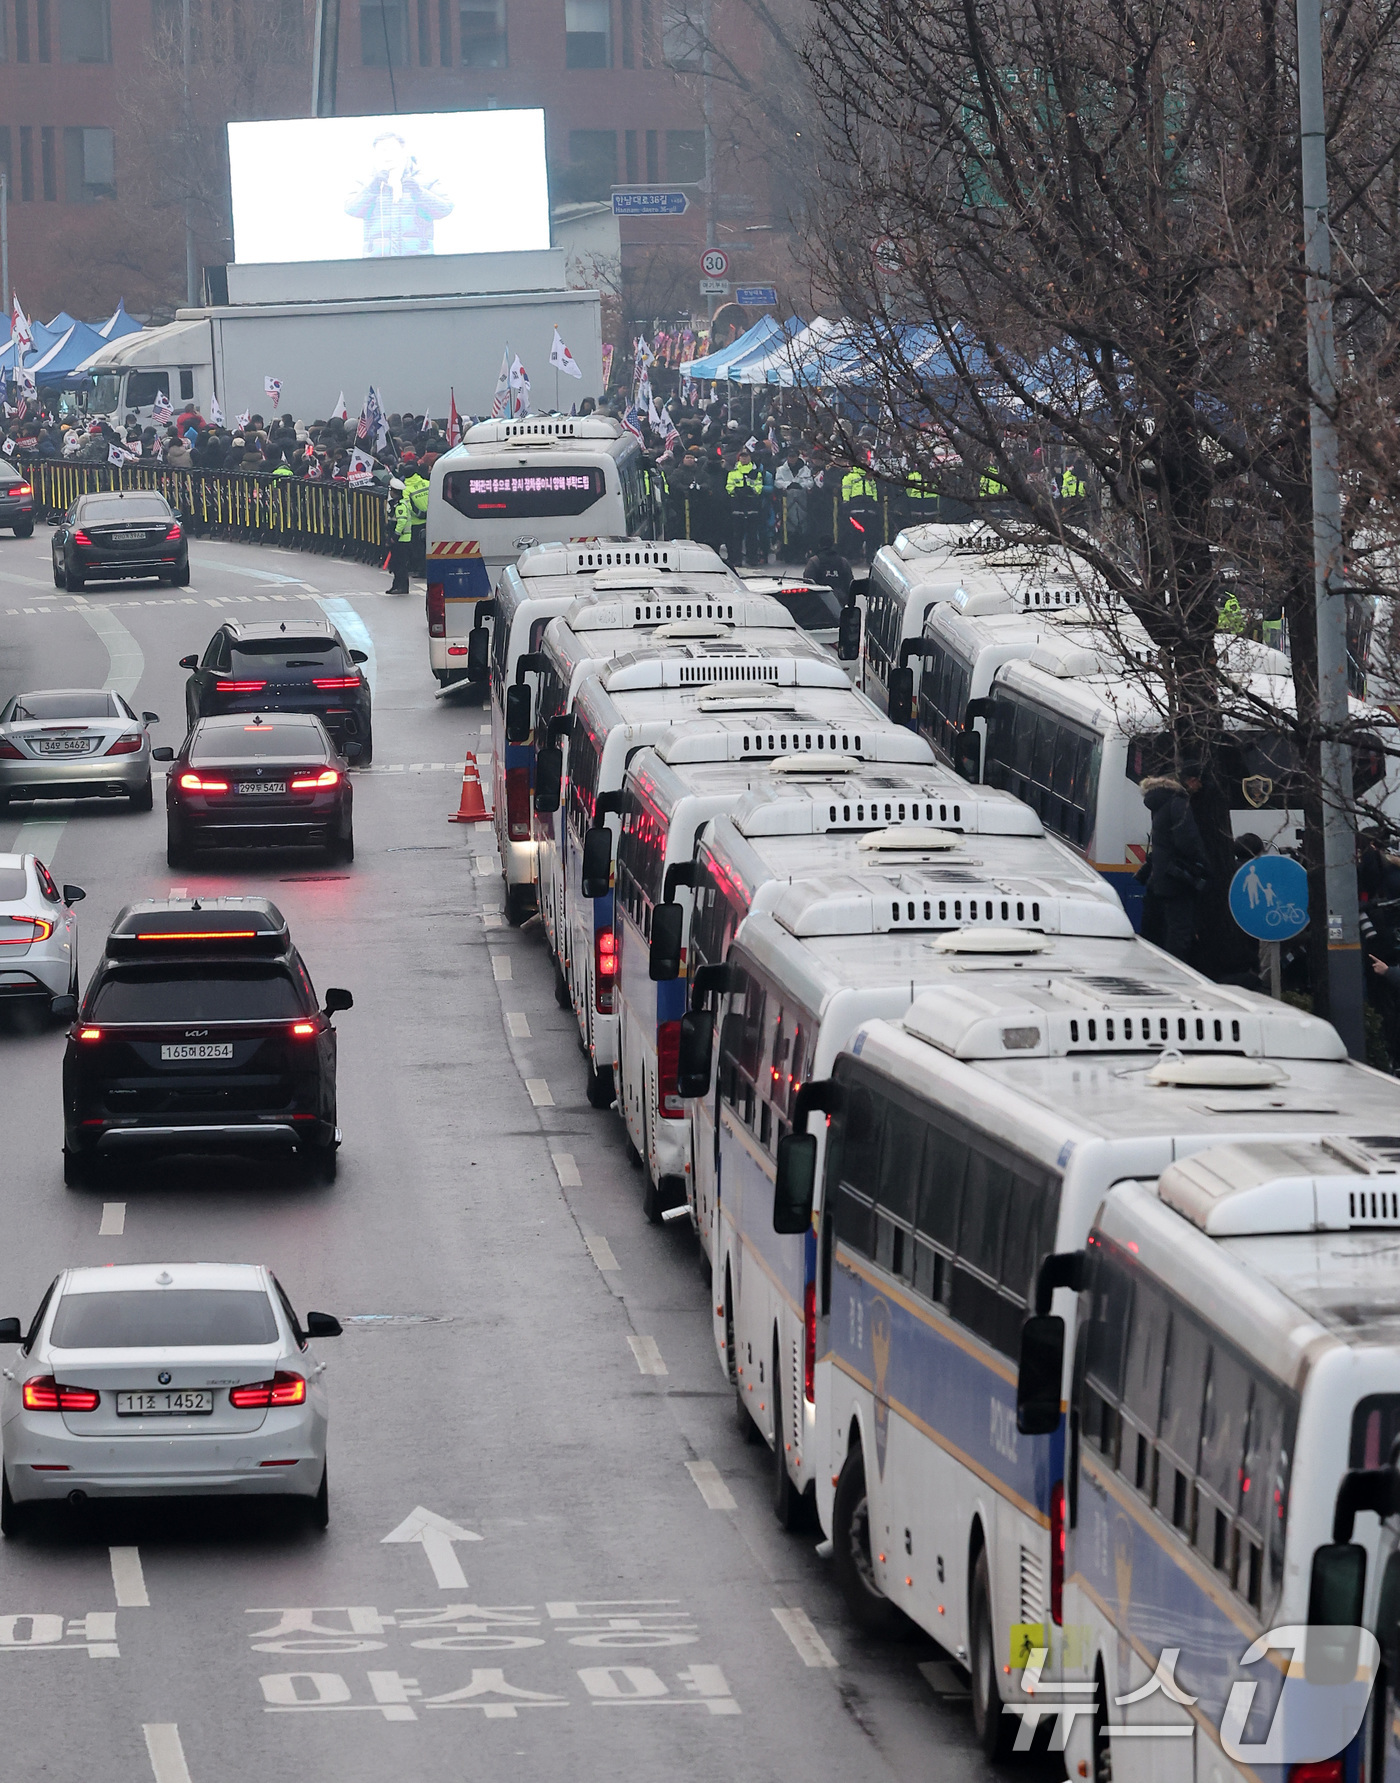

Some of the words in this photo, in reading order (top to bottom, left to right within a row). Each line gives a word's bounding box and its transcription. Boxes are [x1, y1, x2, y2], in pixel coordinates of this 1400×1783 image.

[615, 195, 668, 206] 한남대로36길
[706, 256, 724, 270] 30
[469, 479, 492, 493] 집회관리
[493, 479, 511, 492] 중으로
[511, 478, 524, 491] 잠시
[553, 476, 566, 490] 양해
[566, 475, 590, 490] 부탁드립
[44, 742, 61, 750] 34모
[64, 741, 86, 749] 5462
[240, 784, 262, 793] 299두
[263, 783, 285, 792] 5474
[166, 1046, 197, 1058] 165허
[198, 1045, 230, 1057] 8254
[126, 1395, 156, 1409] 11조
[165, 1394, 204, 1409] 1452
[244, 1600, 700, 1654] 장충동
[259, 1664, 742, 1721] 약수역
